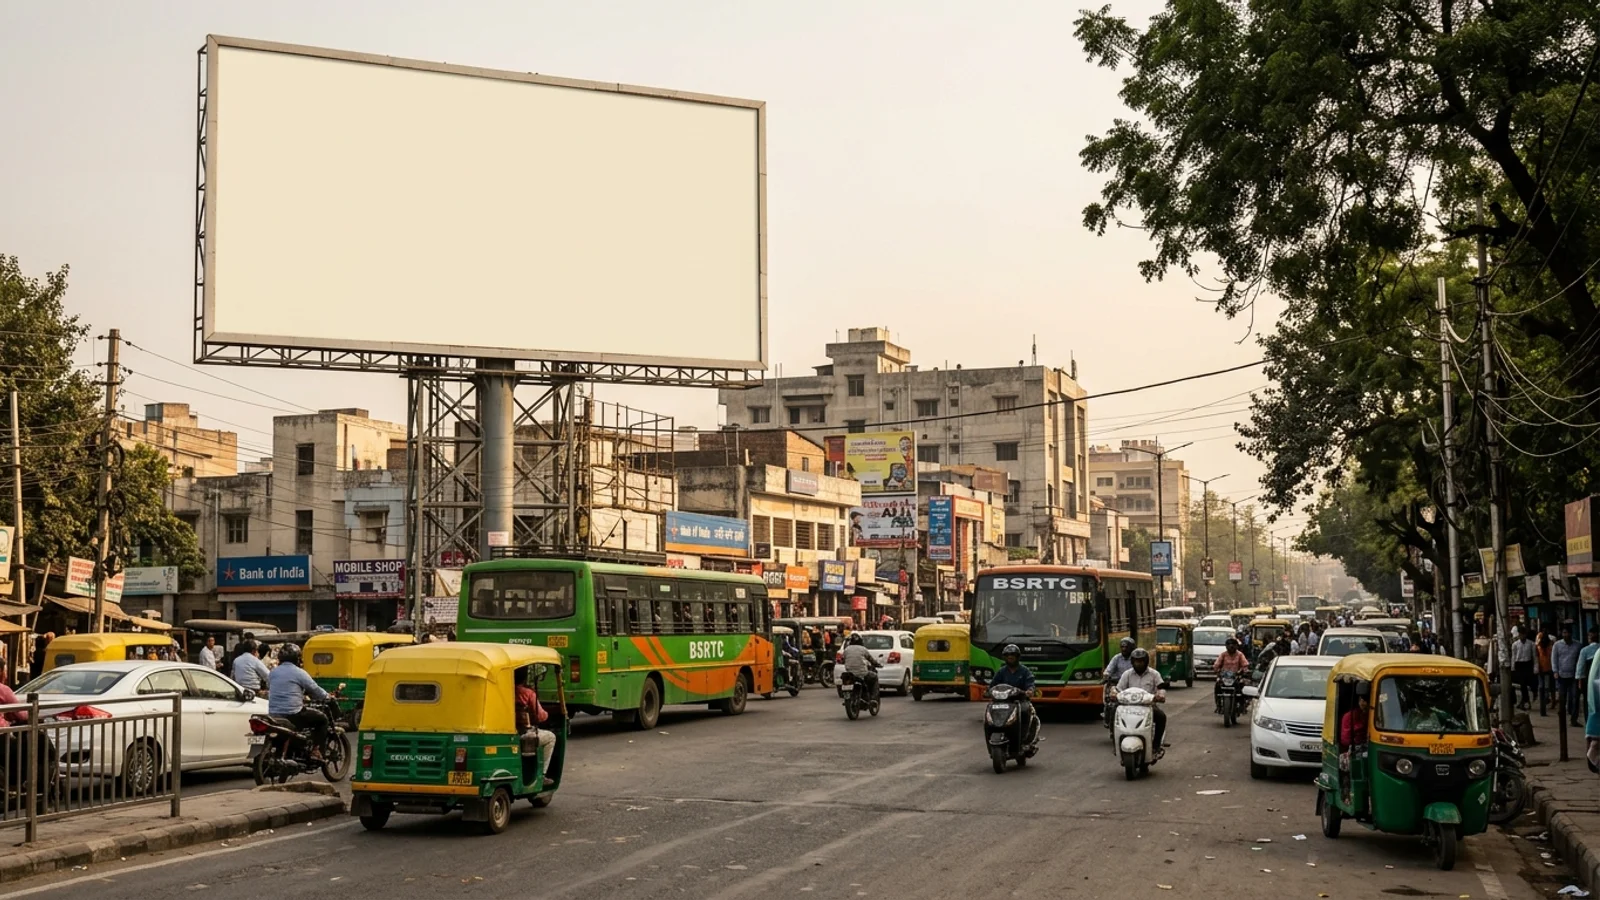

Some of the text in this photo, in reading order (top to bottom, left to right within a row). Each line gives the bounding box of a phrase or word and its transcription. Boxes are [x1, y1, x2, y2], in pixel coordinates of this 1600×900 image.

[239, 566, 305, 580] Bank of India
[335, 561, 402, 573] MOBILE SHOP
[992, 577, 1077, 590] BSRTC
[689, 640, 724, 659] BSRTC
